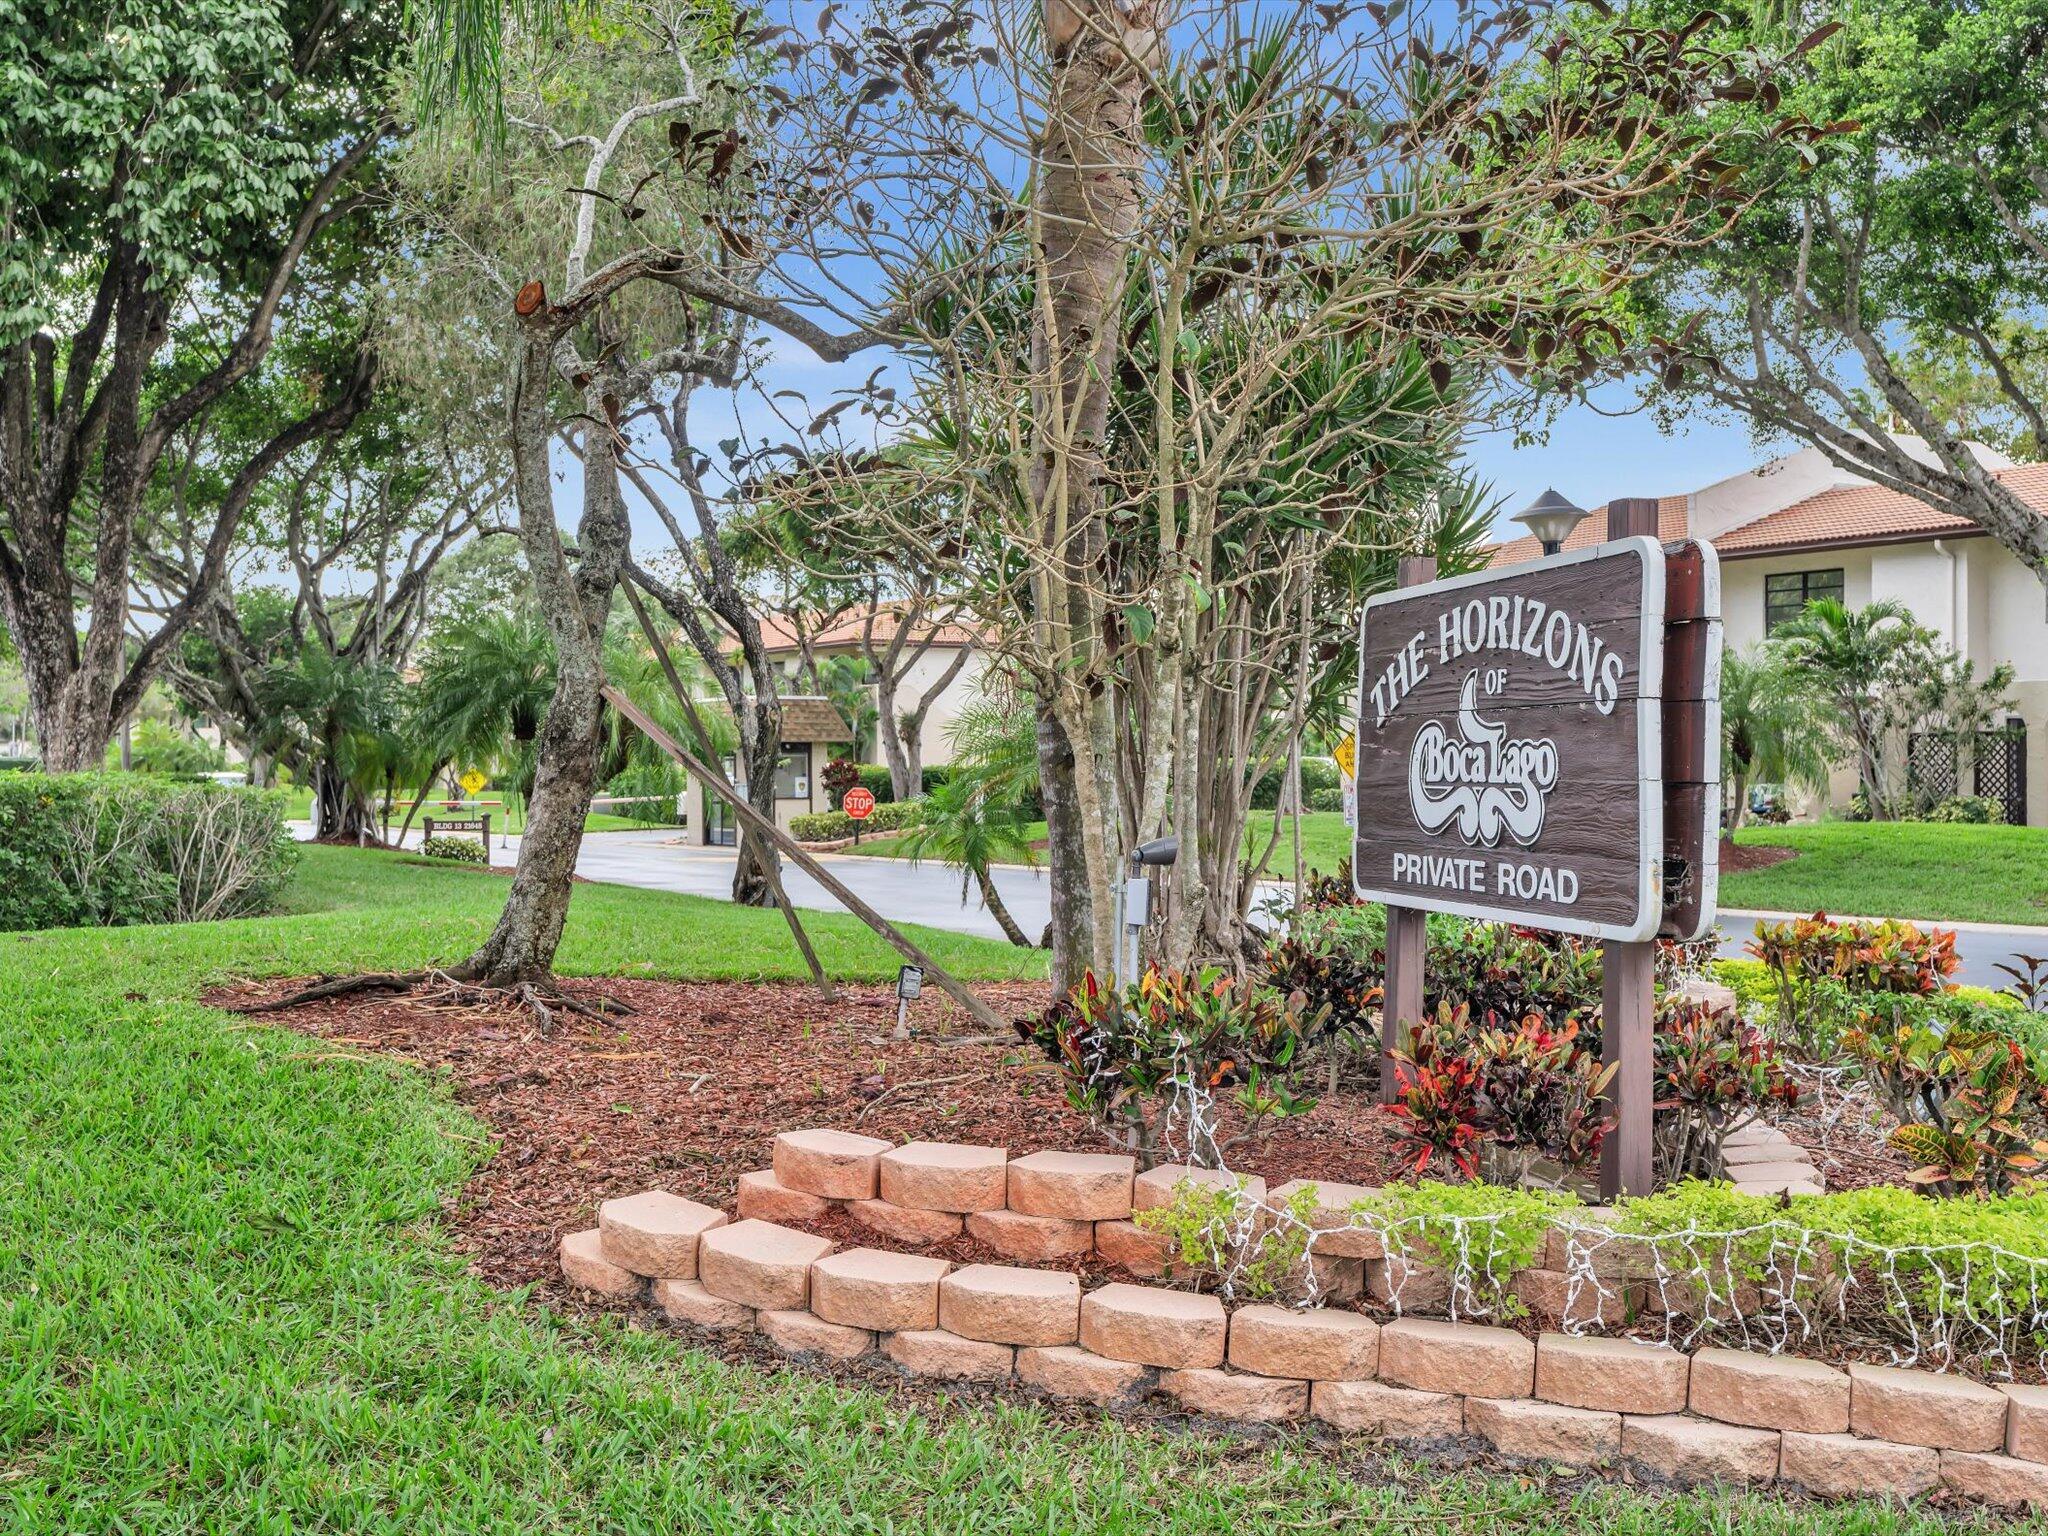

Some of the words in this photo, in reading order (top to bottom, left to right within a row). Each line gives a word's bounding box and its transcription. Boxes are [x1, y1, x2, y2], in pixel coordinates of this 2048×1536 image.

[1371, 631, 1428, 727] THE
[1439, 595, 1623, 715] HORIZONS
[1485, 668, 1507, 695] OF
[845, 797, 871, 810] STOP
[433, 822, 453, 830] BLDG
[454, 822, 463, 830] 13
[1393, 852, 1486, 892] PRIVATE
[1497, 862, 1579, 905] ROAD
